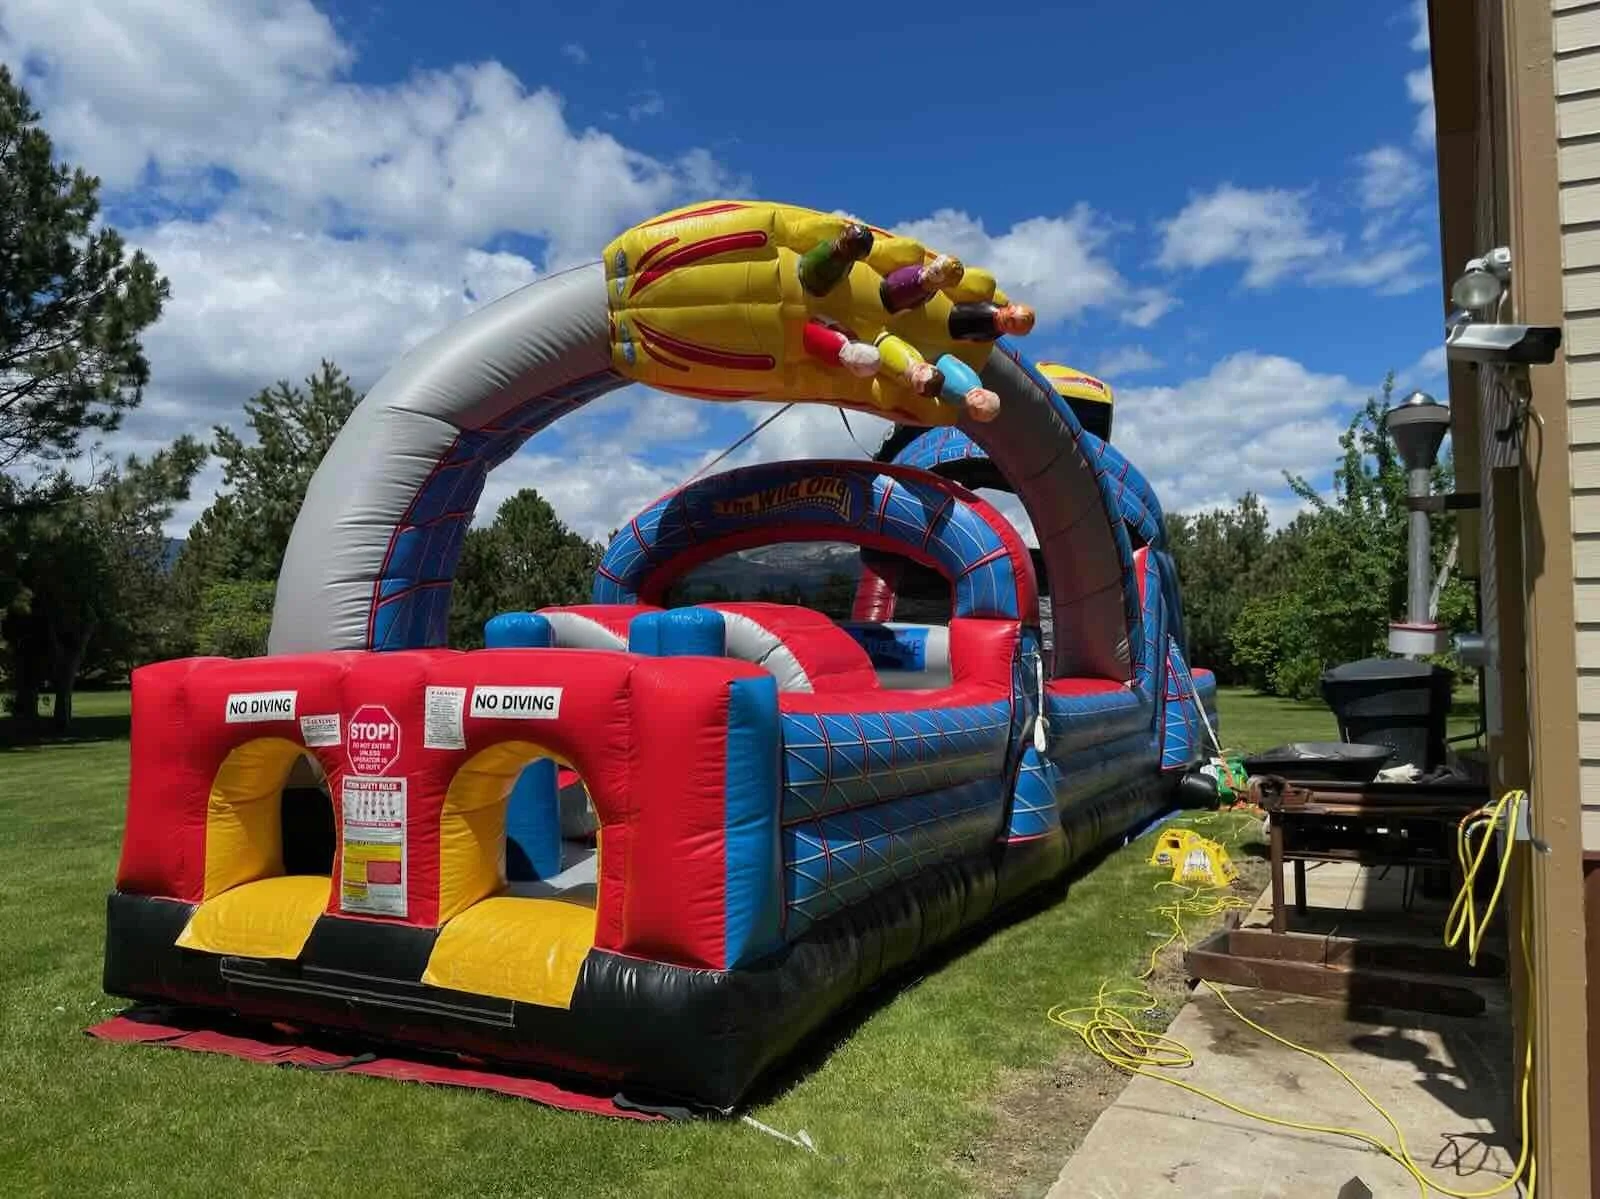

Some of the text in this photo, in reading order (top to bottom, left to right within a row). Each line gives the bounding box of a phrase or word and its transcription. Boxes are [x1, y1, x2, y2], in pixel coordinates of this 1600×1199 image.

[229, 698, 291, 716] NO DIVING
[475, 694, 554, 710] NO DIVING
[351, 723, 394, 740] STOP!
[371, 742, 391, 750] ENTER
[360, 782, 377, 790] SAFETY
